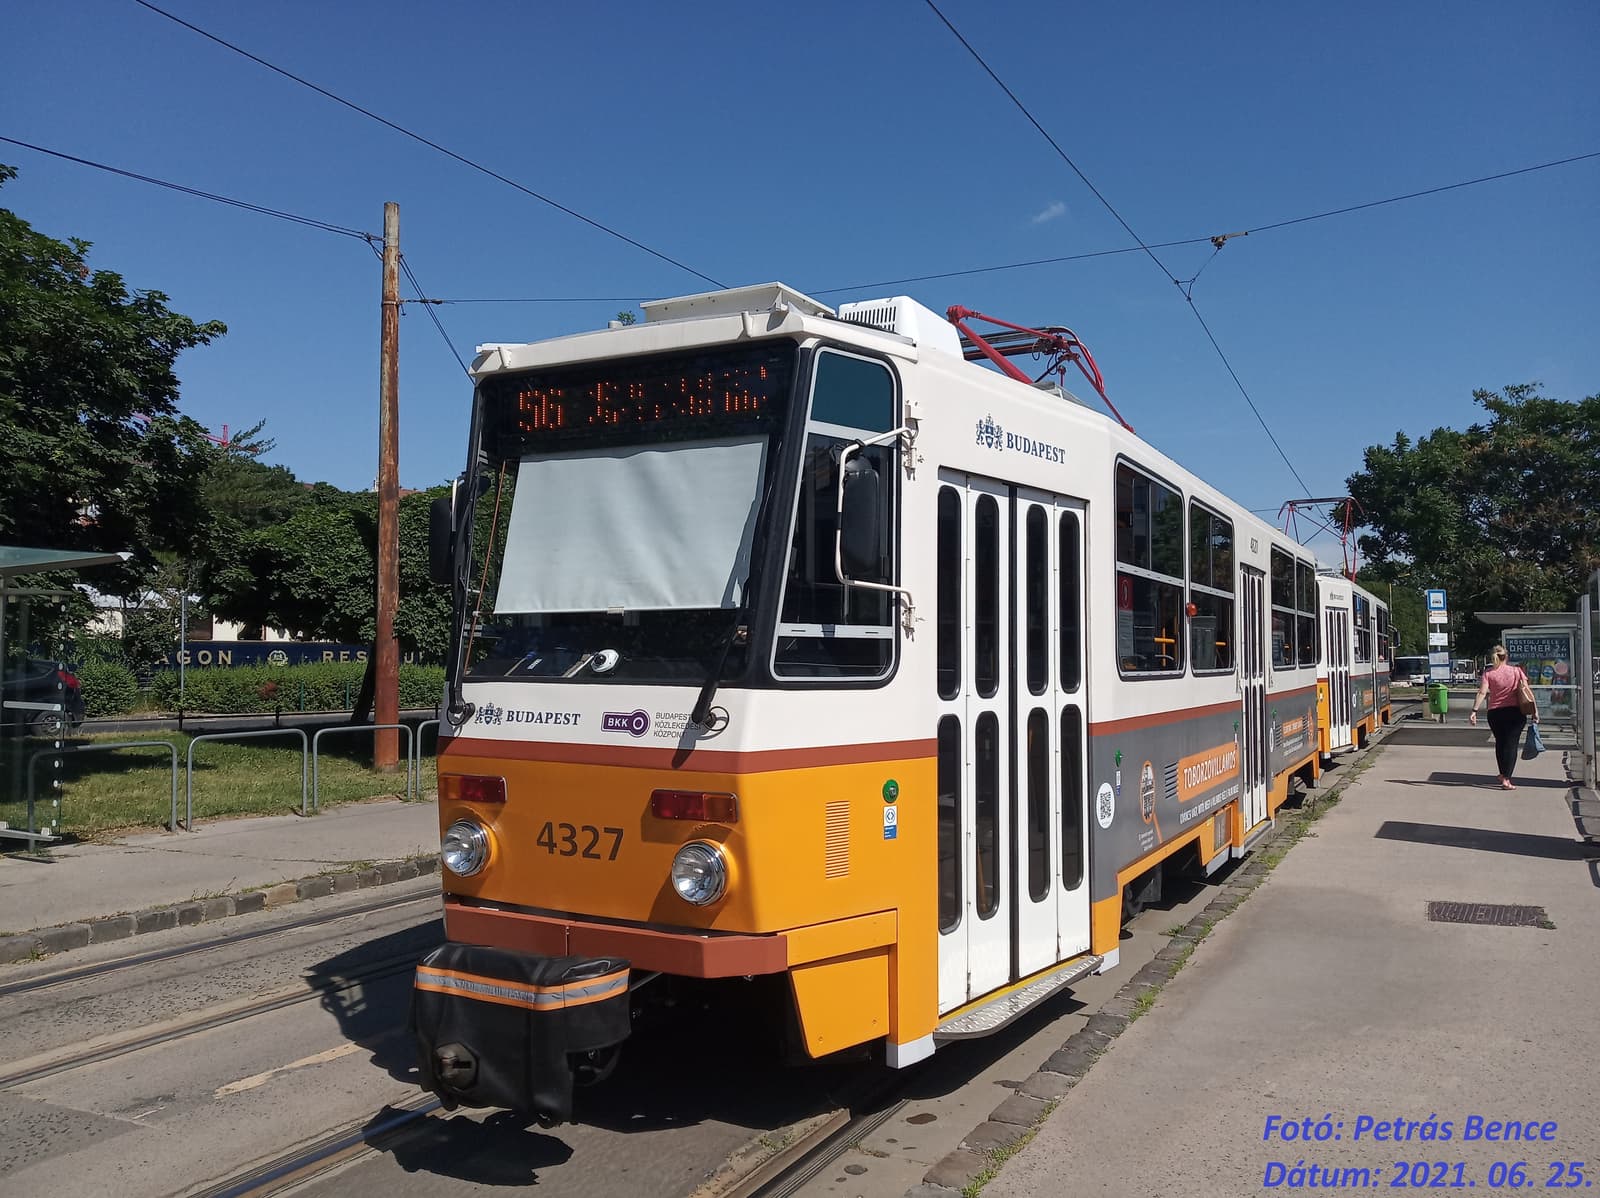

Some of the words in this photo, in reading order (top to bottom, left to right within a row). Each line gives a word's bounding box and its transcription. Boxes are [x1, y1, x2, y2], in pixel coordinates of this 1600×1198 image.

[1006, 432, 1065, 464] BUDAPEST
[153, 649, 232, 665] AGON
[505, 709, 581, 726] BUDAPEST
[607, 717, 629, 728] BKK
[655, 711, 692, 721] BUDAPEST
[536, 821, 624, 861] 4327
